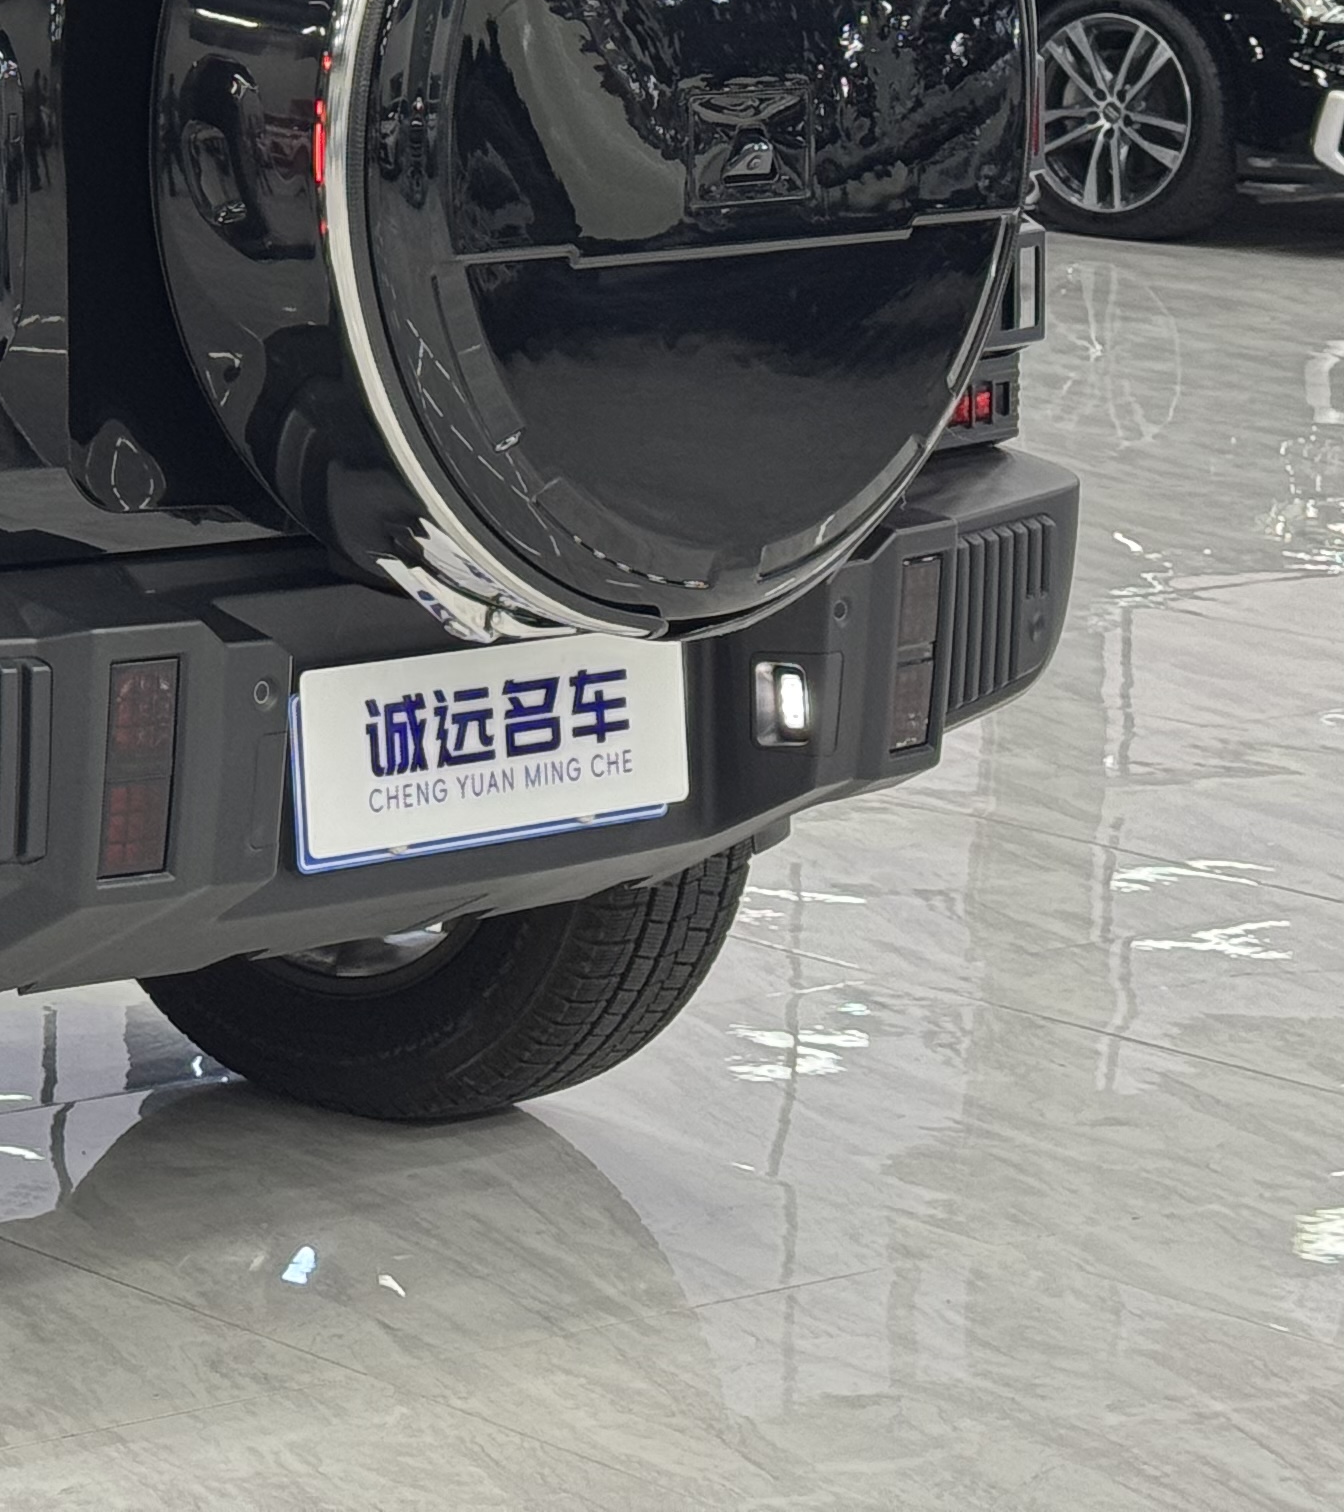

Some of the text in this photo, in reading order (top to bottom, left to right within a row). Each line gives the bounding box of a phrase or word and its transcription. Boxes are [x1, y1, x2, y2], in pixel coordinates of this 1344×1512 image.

[365, 669, 629, 776] 诚远名车
[368, 748, 634, 813] CHENG YUAN MING CHE
